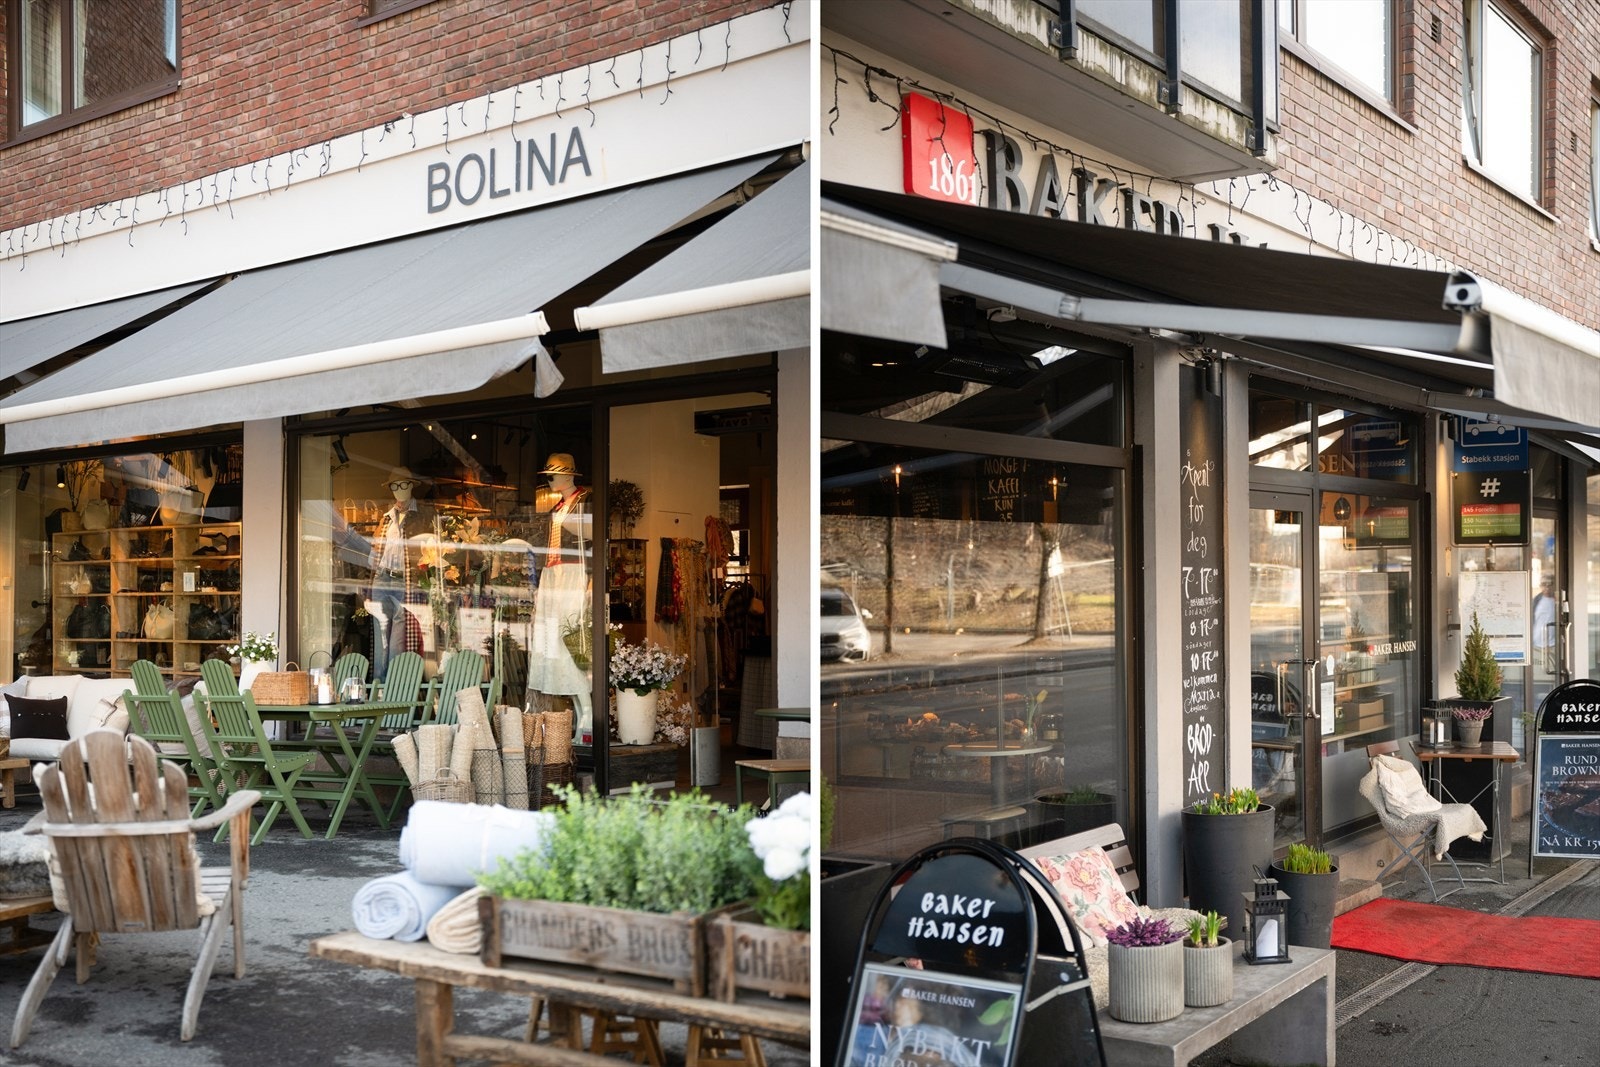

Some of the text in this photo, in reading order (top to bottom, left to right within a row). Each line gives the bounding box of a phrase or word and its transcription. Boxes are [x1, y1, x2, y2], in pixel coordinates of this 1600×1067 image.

[427, 126, 592, 214] BOLINA
[1461, 453, 1520, 464] Stabekk stasjon
[1186, 530, 1208, 559] deg
[1373, 640, 1417, 656] BAKER HANSEN
[1565, 755, 1598, 765] RUND
[1542, 834, 1560, 847] NÅ
[1564, 836, 1582, 847] KR
[907, 917, 1005, 947] Hansen
[910, 988, 976, 1008] BAKER HANSEN
[868, 1022, 991, 1067] NYBAKT
